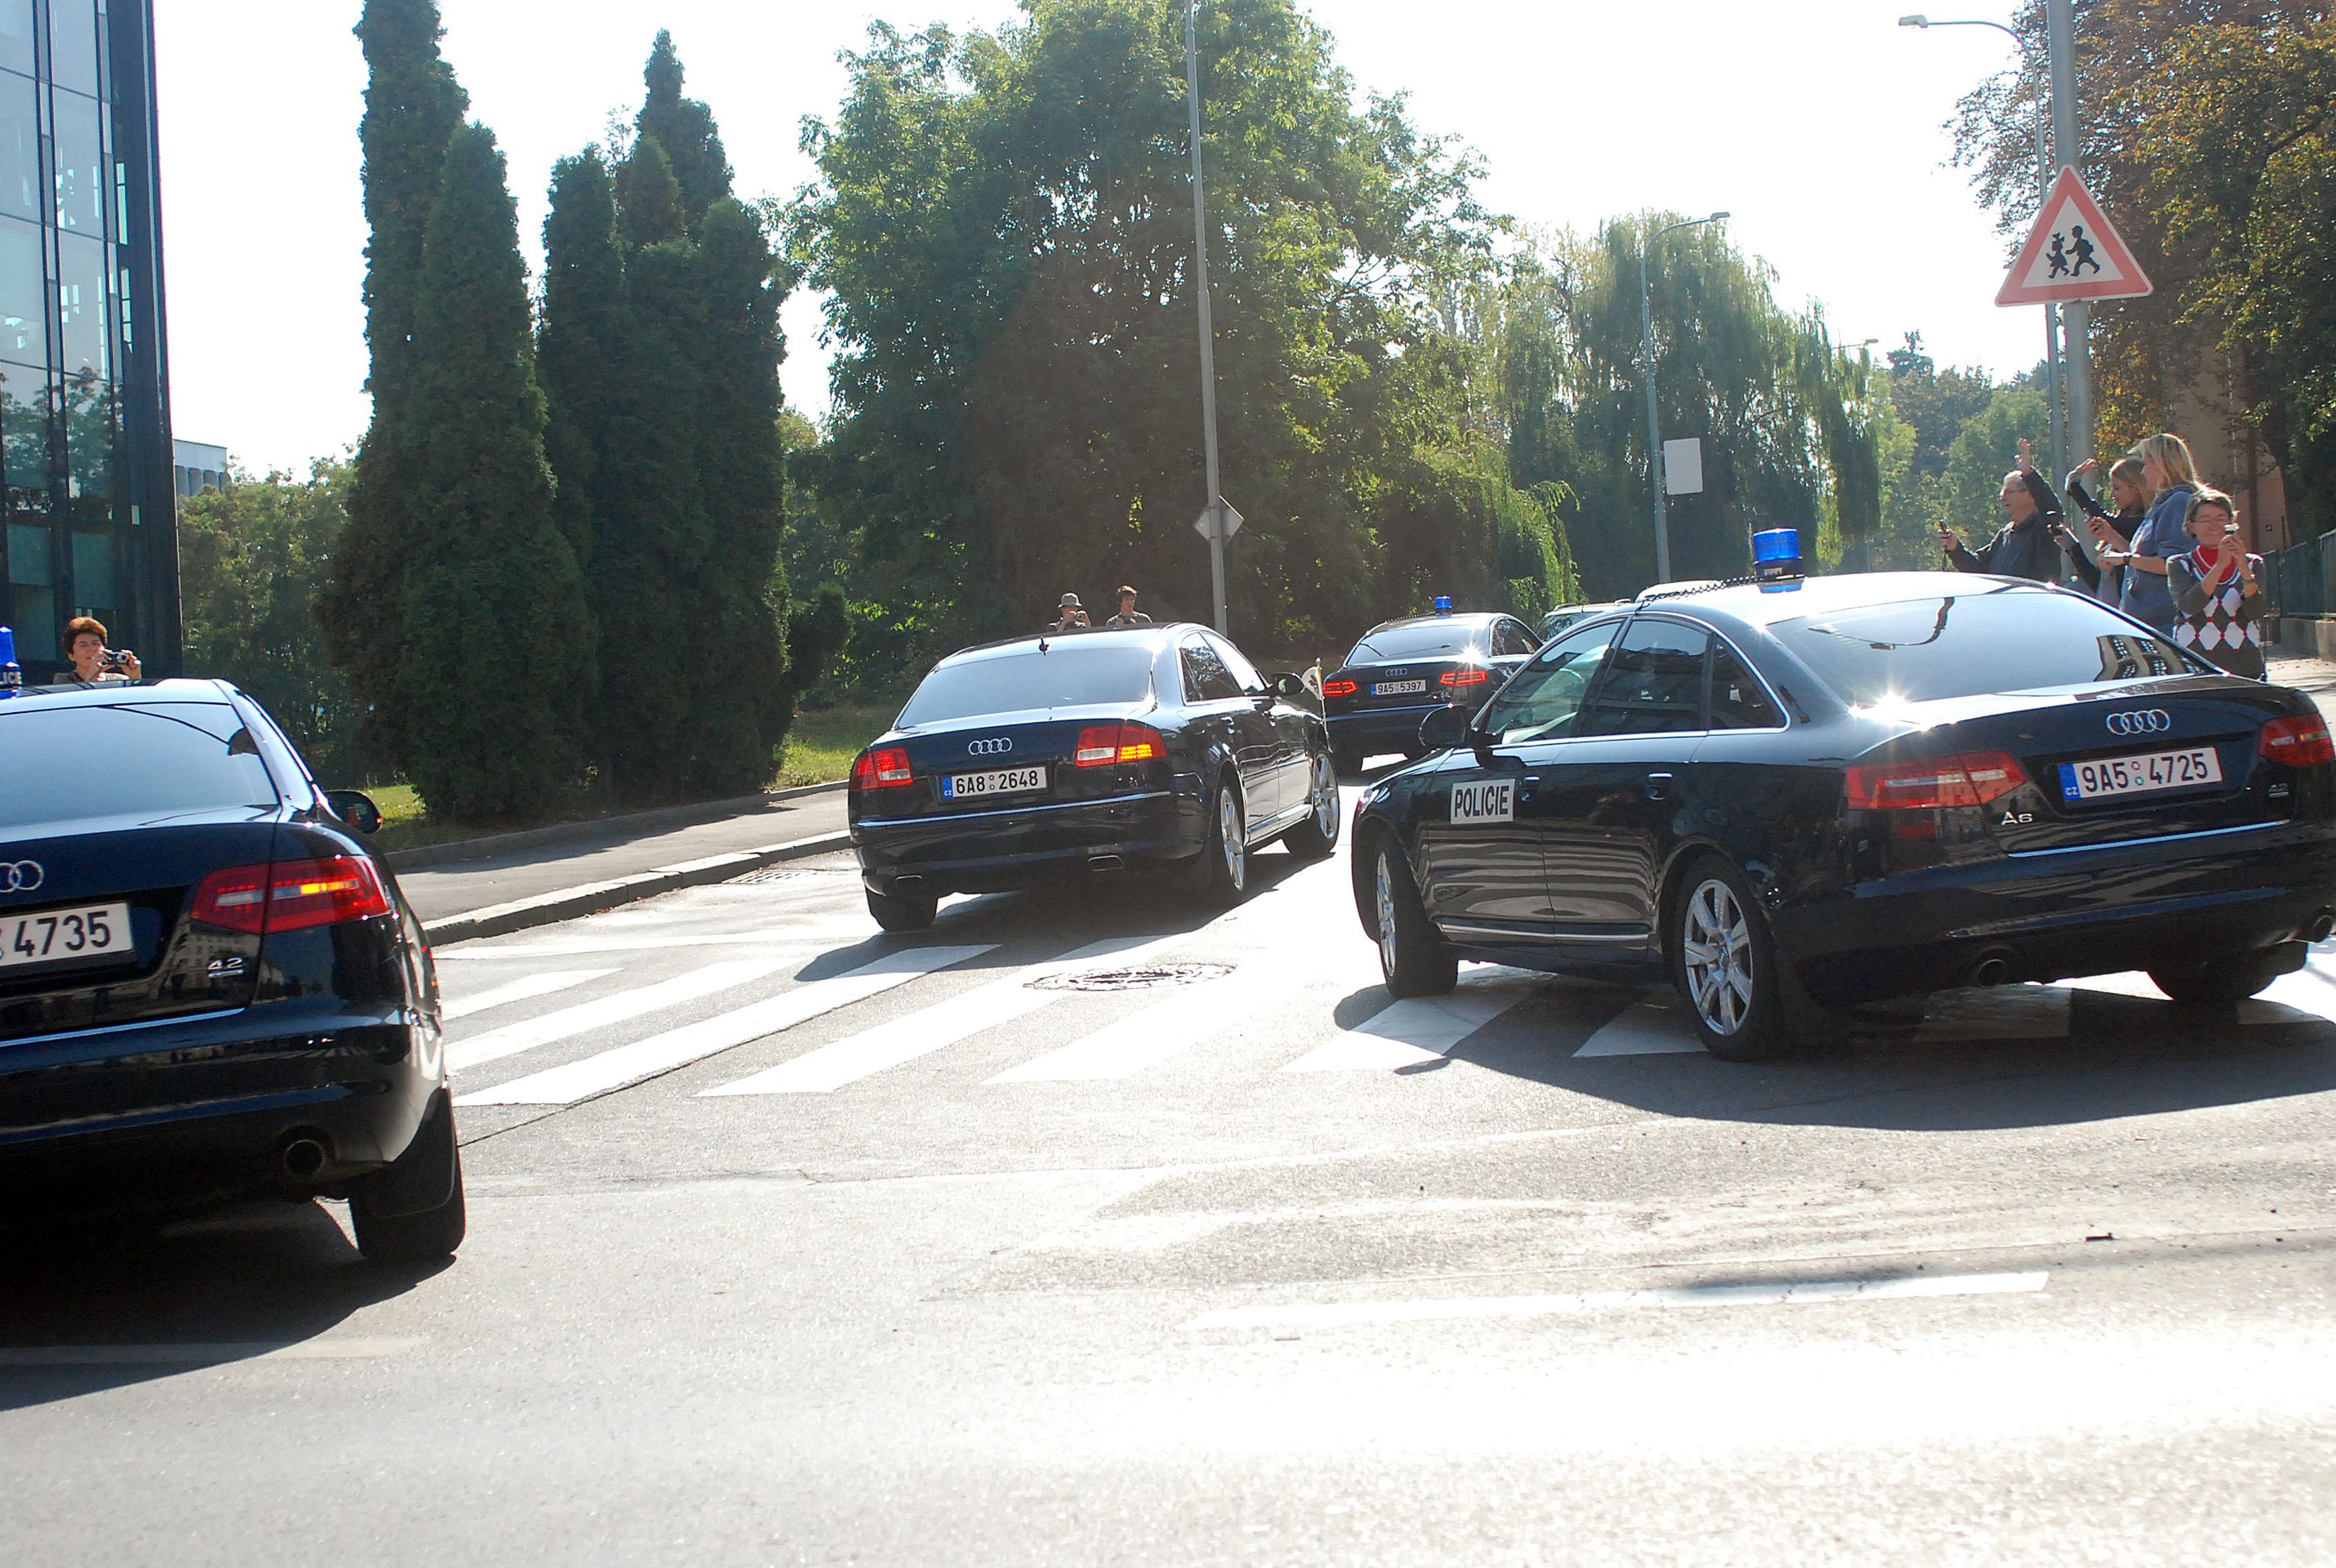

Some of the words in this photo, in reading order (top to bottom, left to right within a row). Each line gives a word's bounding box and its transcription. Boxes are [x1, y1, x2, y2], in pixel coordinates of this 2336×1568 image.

[1378, 684, 1393, 693] 9A5
[1400, 681, 1421, 692] 5397
[956, 776, 985, 794] 6A8
[998, 770, 1038, 790] 2648
[2082, 762, 2129, 792] 9A5
[2149, 753, 2209, 784] 4725
[1455, 786, 1509, 818] POLICIE
[2066, 786, 2079, 796] CZ
[2001, 812, 2033, 826] A6
[14, 911, 111, 957] 4735
